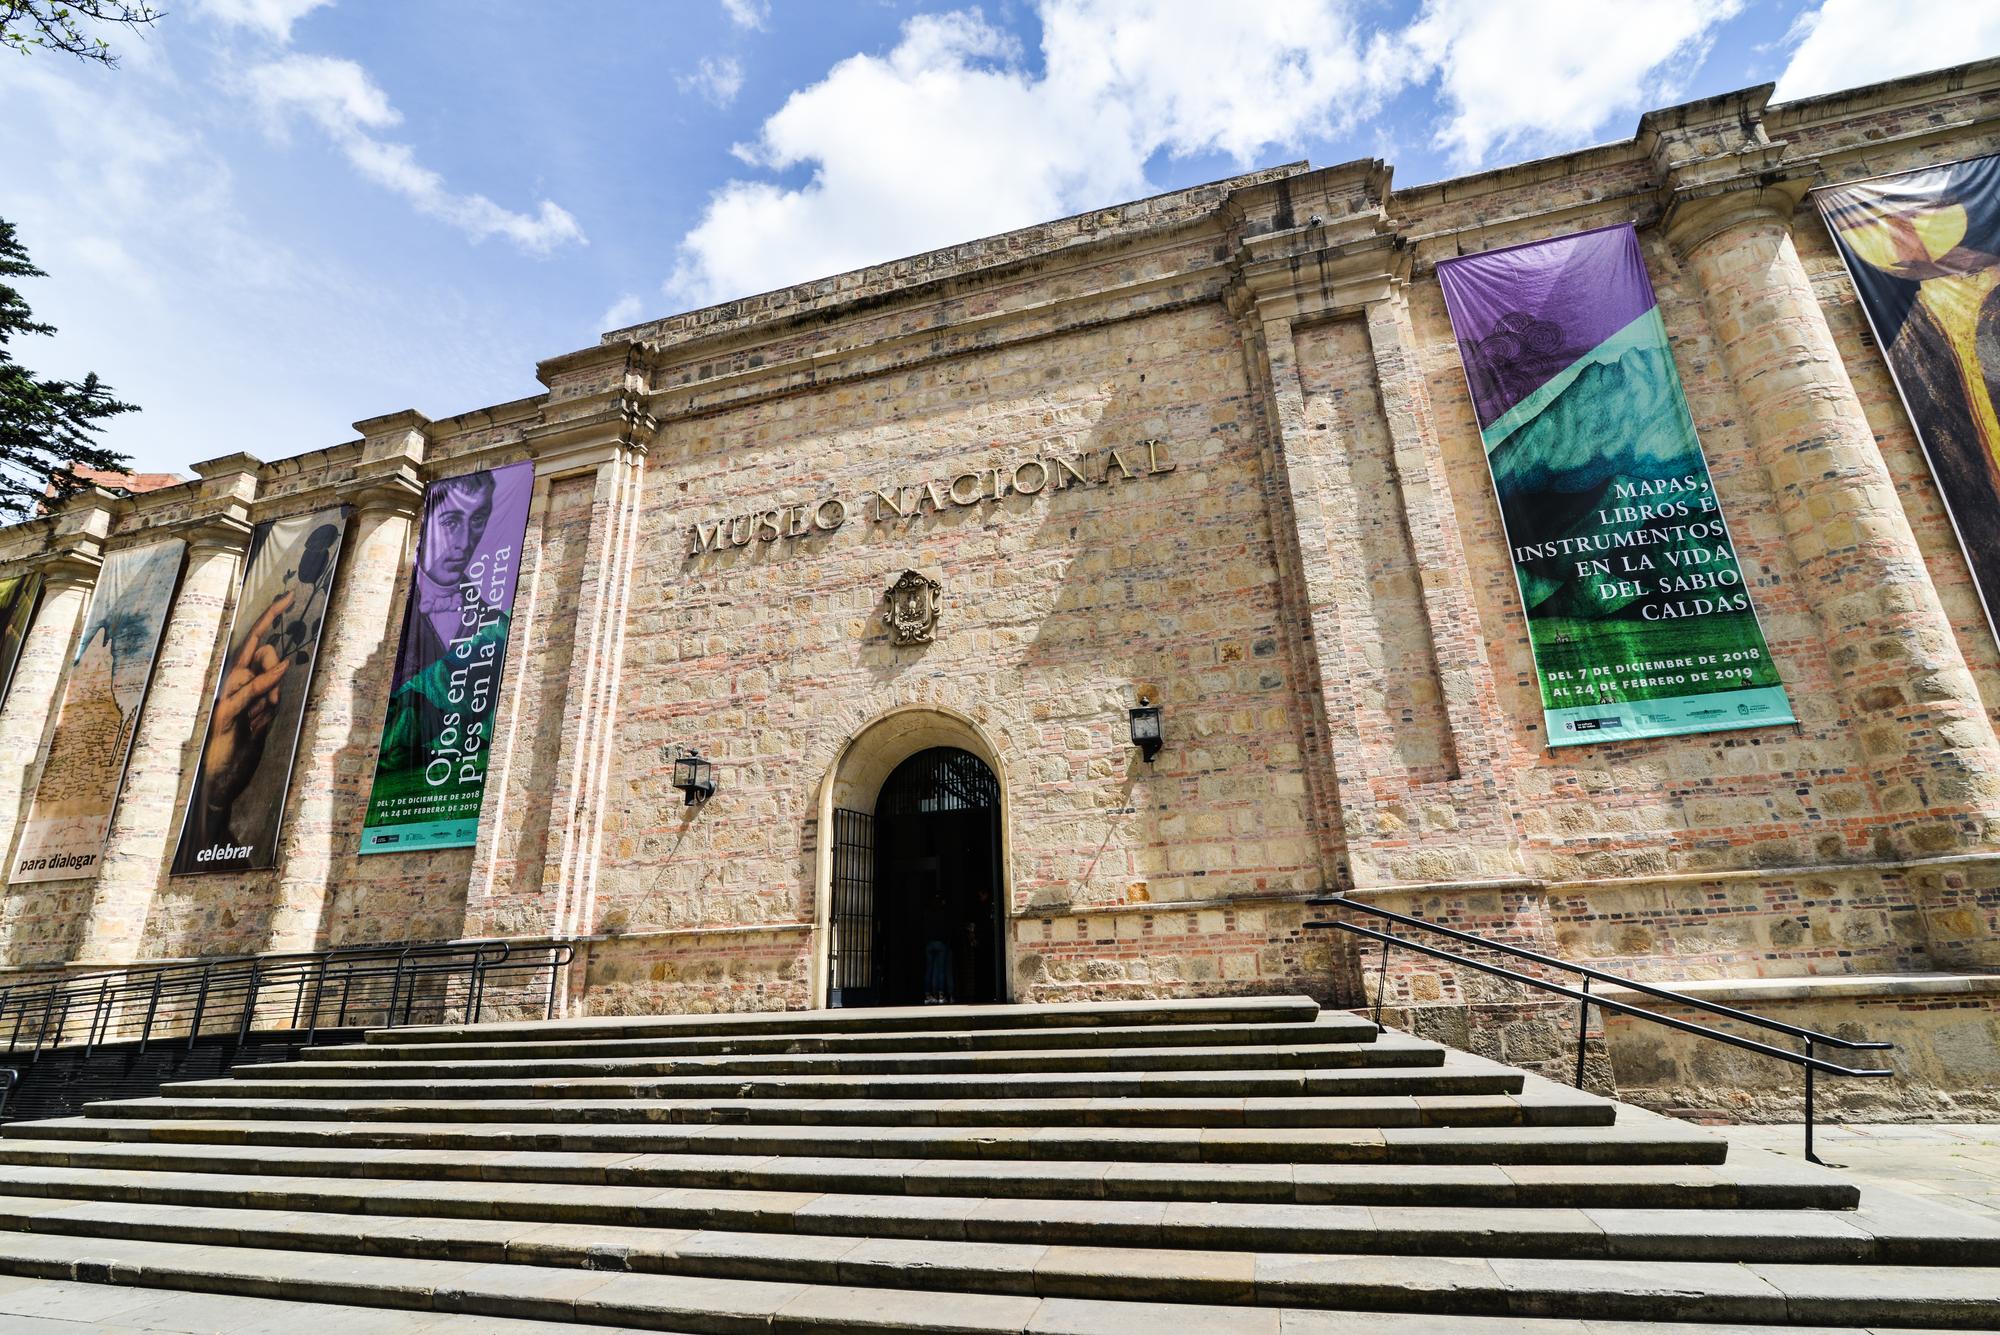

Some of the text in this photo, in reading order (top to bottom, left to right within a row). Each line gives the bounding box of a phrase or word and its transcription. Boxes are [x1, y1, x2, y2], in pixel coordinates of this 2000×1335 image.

[690, 439, 1178, 555] MUSEO NACIONAL
[1614, 474, 1709, 500] MAPAS,
[1598, 496, 1717, 526] LIBROS E
[1515, 519, 1725, 563] INSTRUMENTOS
[1575, 544, 1733, 578] EN LA VIDA
[1599, 569, 1739, 600] DEL SABIO
[1641, 593, 1748, 621] CALDAS
[425, 554, 490, 786] Ojos en el cielo,
[458, 545, 511, 784] pies en la Tierra
[1548, 648, 1760, 682] DEL 7 DE DICIEMBRE DE 2018
[1553, 667, 1753, 698] AL 24 DE FEBRERO DE 2019
[403, 808, 411, 816] DE
[414, 806, 445, 814] FEBRERO
[447, 804, 457, 812] DE
[459, 803, 478, 811] 2019
[408, 795, 447, 804] DICIEMBRE
[461, 790, 480, 799] 2018
[19, 853, 97, 874] para dialogar
[196, 843, 254, 862] celebrar
